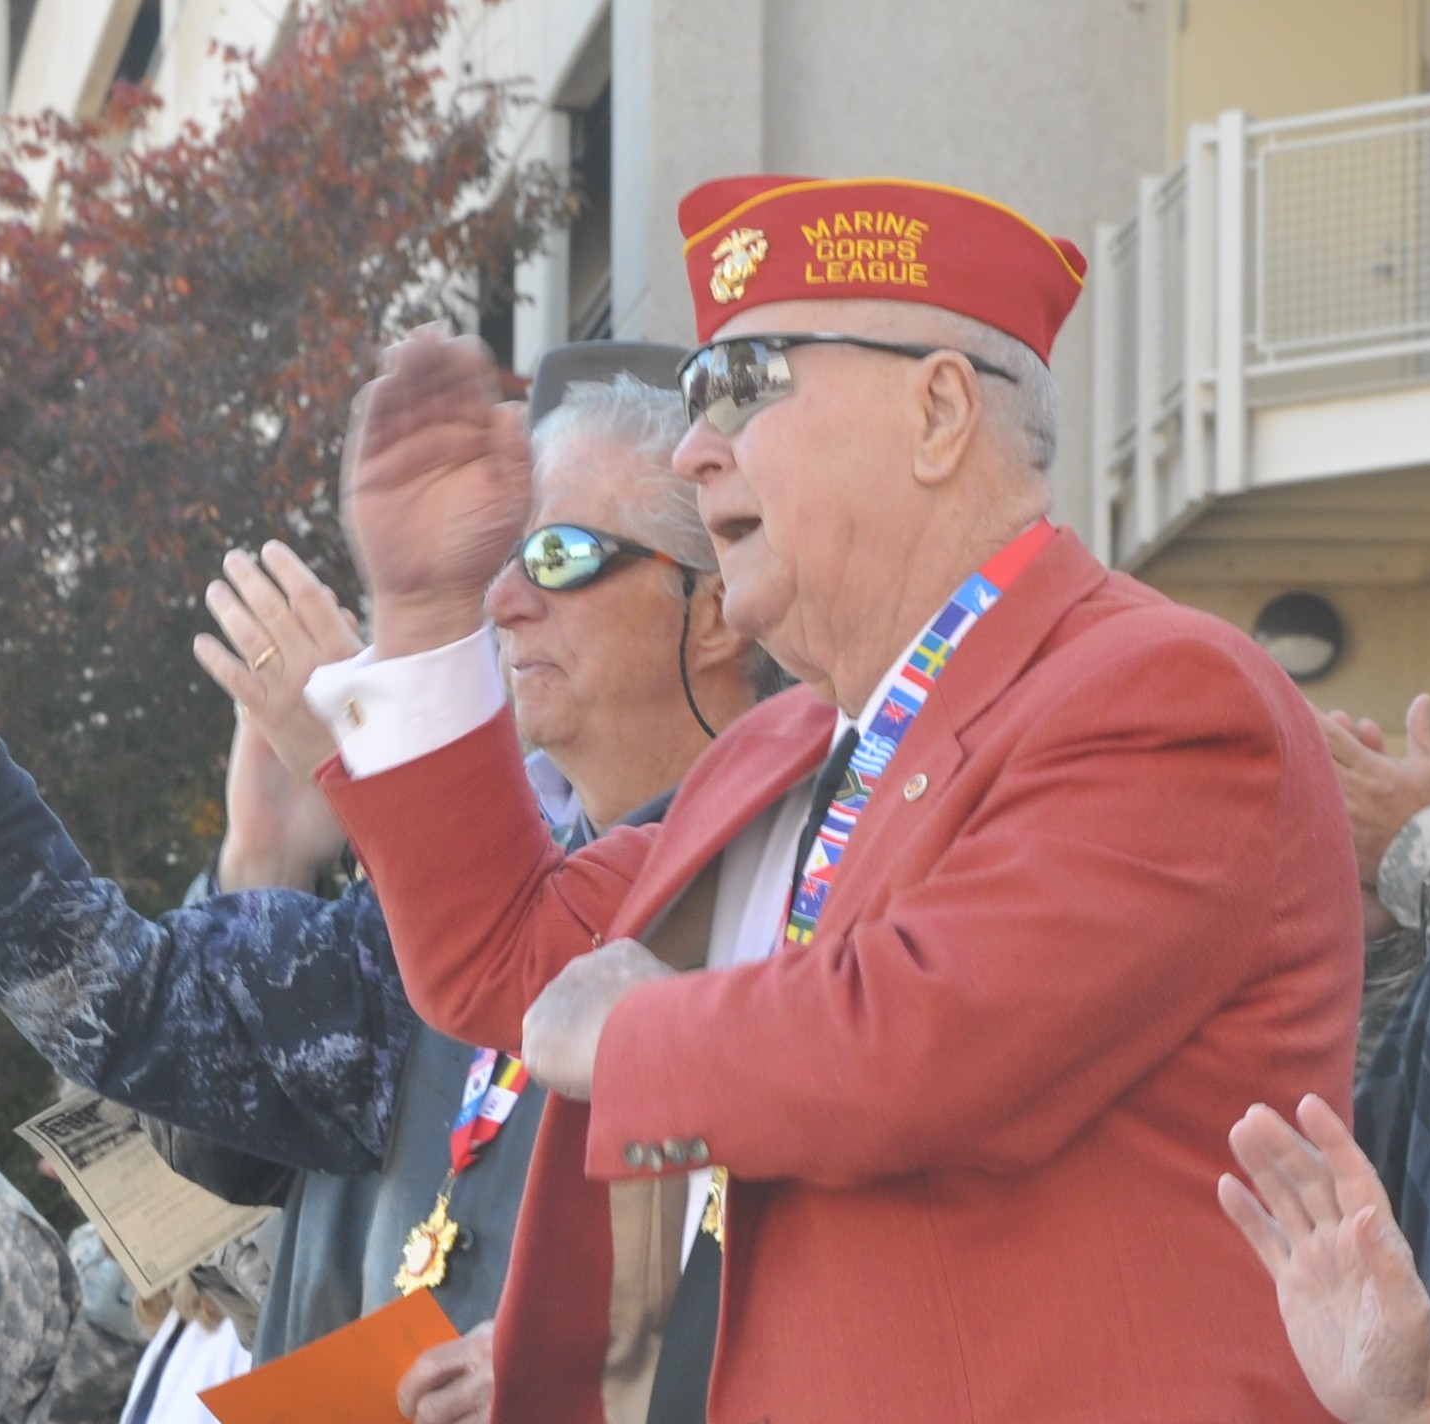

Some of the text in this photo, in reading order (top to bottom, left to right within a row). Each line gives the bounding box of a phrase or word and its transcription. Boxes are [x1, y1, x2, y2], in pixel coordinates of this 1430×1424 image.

[800, 210, 929, 246] MARINE
[816, 238, 917, 262] CORPS
[805, 260, 928, 288] LEAGUE
